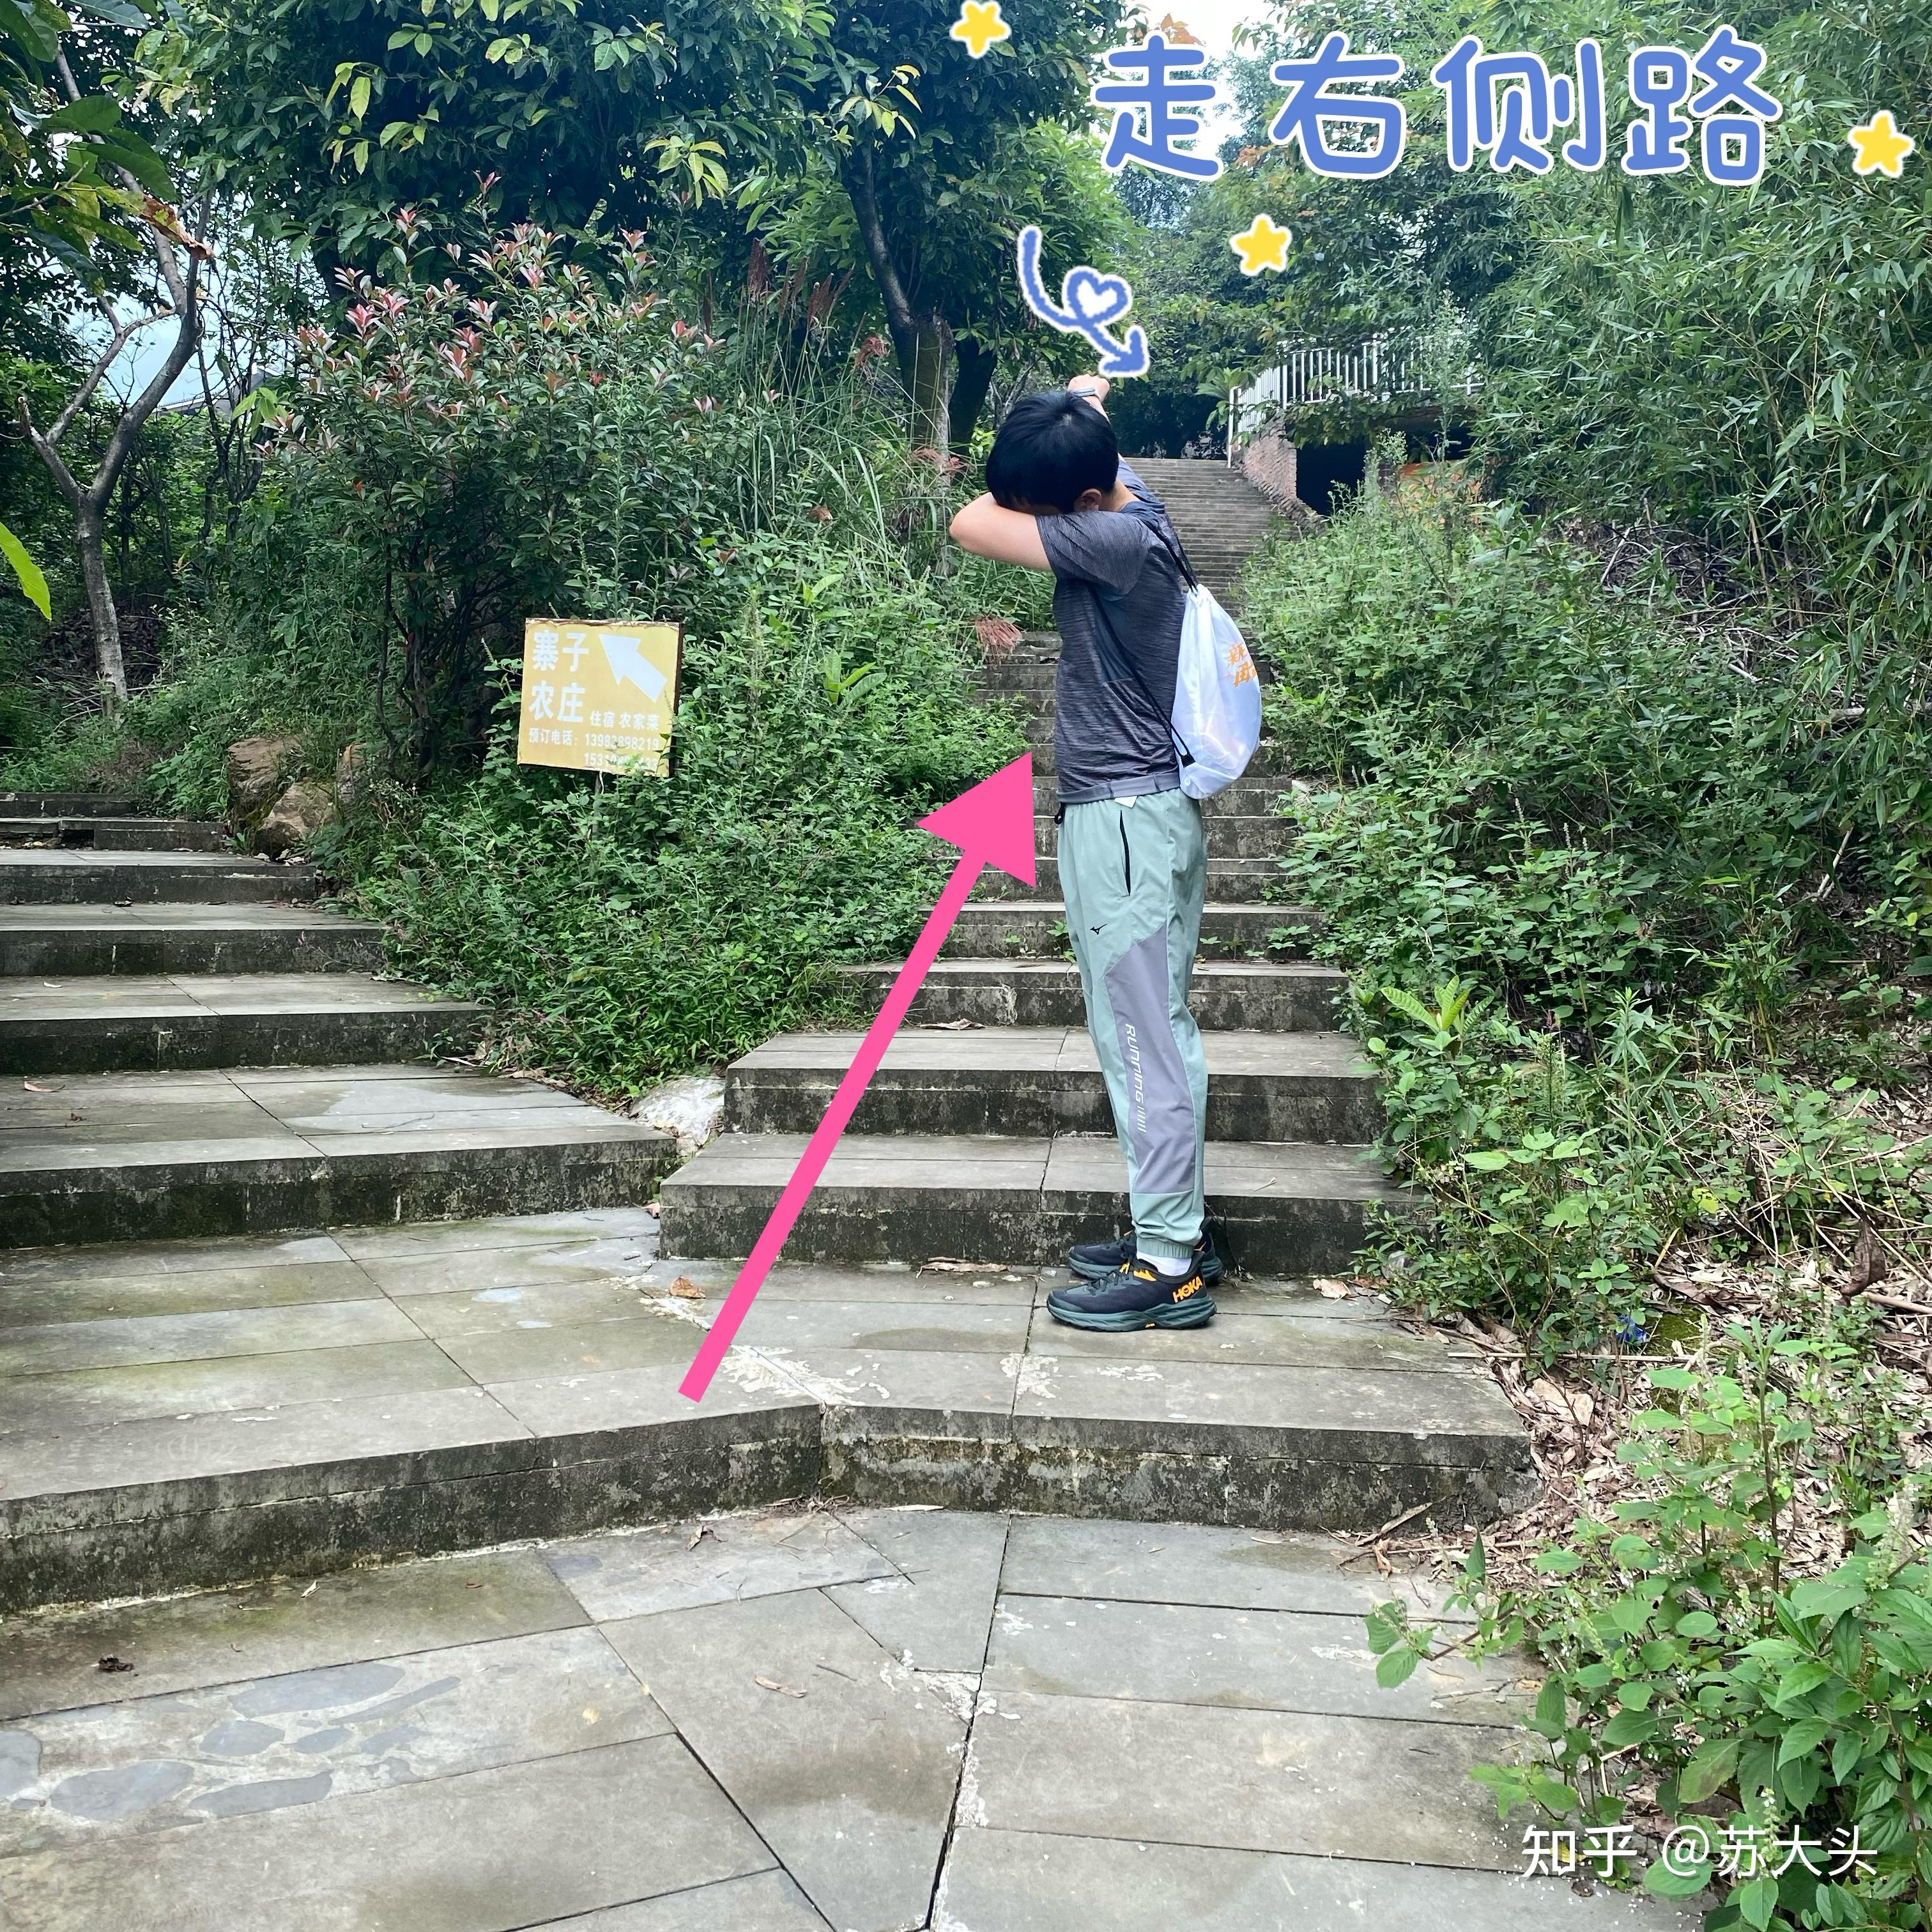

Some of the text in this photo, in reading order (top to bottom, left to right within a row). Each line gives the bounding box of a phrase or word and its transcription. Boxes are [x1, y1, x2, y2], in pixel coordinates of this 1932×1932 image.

[532, 629, 589, 671] 寨子
[528, 680, 585, 723] 农庄
[590, 710, 659, 730] 住宿 农家菜
[1172, 1276, 1203, 1303] HOKA
